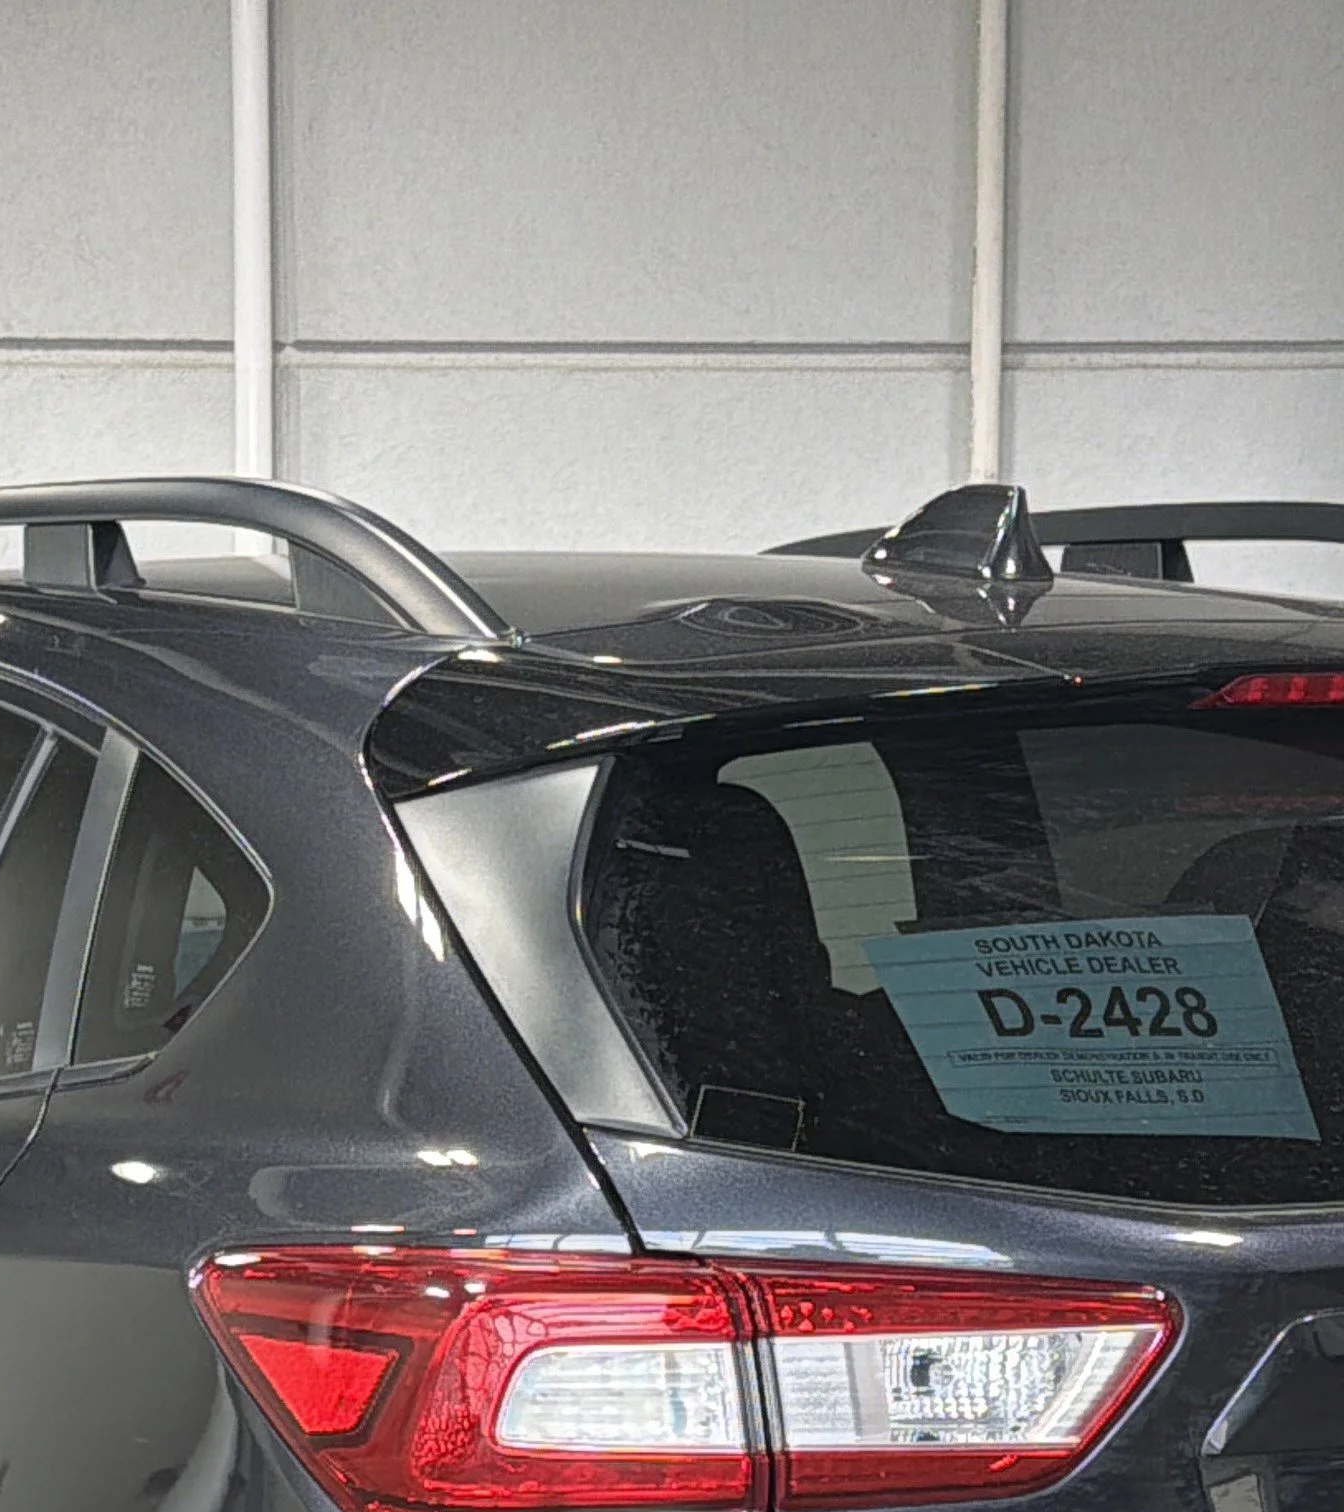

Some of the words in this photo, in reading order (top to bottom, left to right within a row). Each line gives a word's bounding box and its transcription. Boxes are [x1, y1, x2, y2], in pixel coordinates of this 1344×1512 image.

[974, 933, 1061, 954] SOUTH
[1063, 930, 1163, 950] DAKOTA
[975, 957, 1084, 978] VEHICLE
[1086, 956, 1182, 976] DEALER
[977, 986, 1219, 1038] D-2428
[1051, 1068, 1131, 1085] SCHULTE
[1132, 1068, 1203, 1085] SUBARU
[1060, 1089, 1114, 1104] SIOUX
[1115, 1089, 1176, 1106] FALLS,
